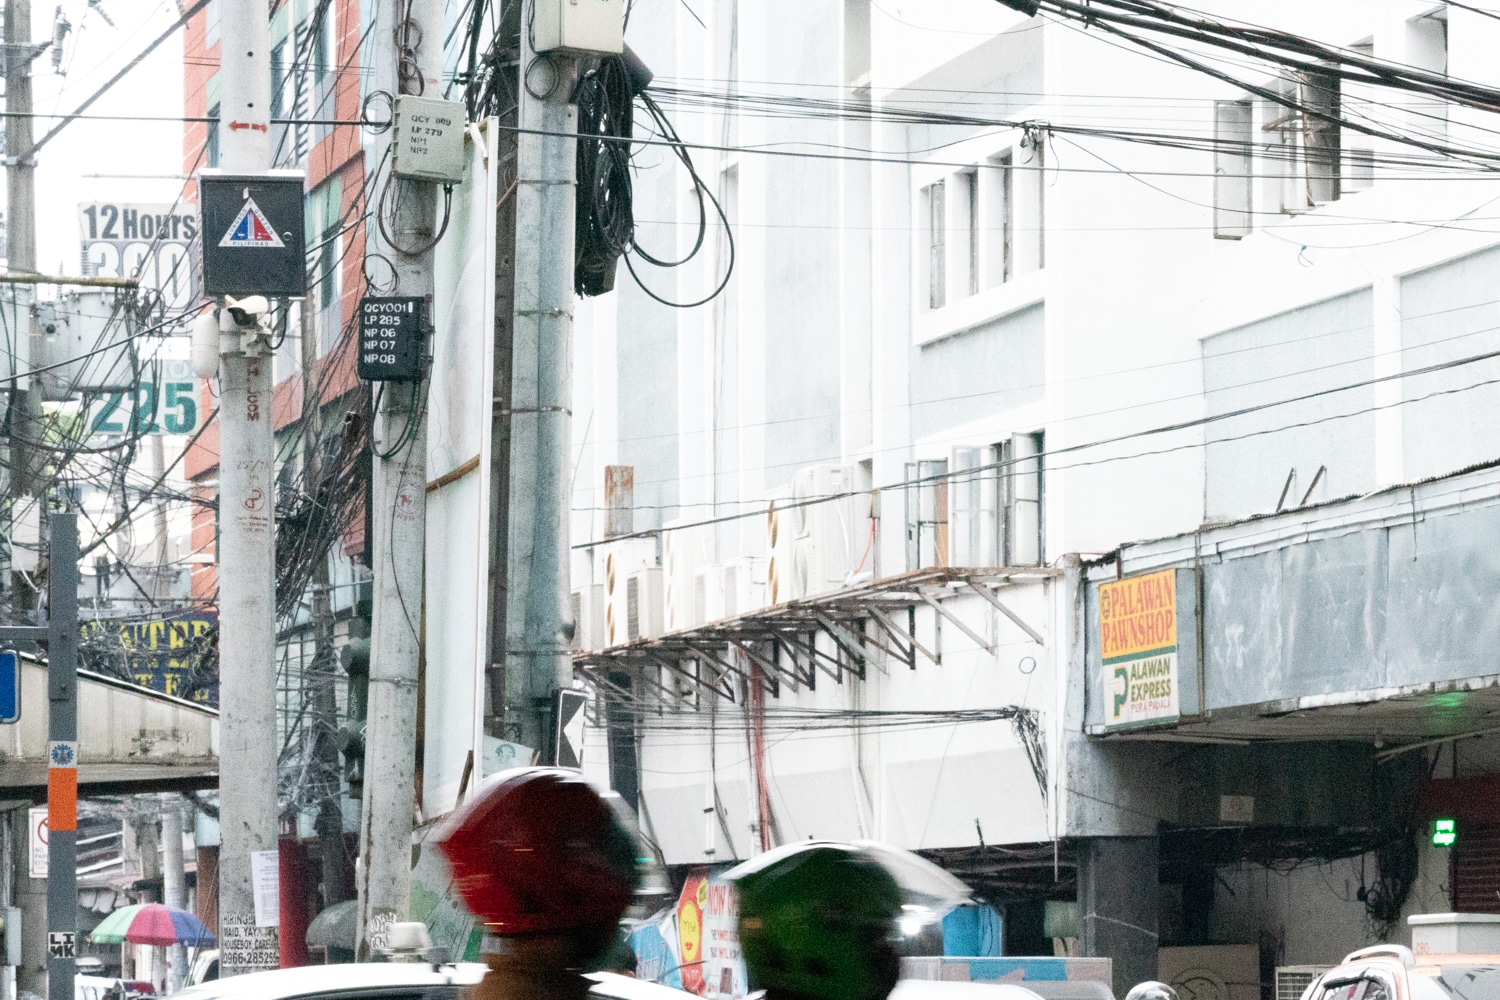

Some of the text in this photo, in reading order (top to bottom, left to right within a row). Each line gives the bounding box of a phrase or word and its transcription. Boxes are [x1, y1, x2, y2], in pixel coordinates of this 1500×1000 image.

[83, 204, 196, 240] 12 Hours
[364, 314, 401, 326] LP 285
[364, 328, 396, 338] NP 06
[364, 340, 396, 350] NP 07
[364, 353, 396, 364] NP 08
[91, 380, 197, 434] 225
[1111, 573, 1173, 619] PALAWAN
[1102, 609, 1174, 653] PAWNSHOP
[1130, 678, 1172, 703] EXPRESS
